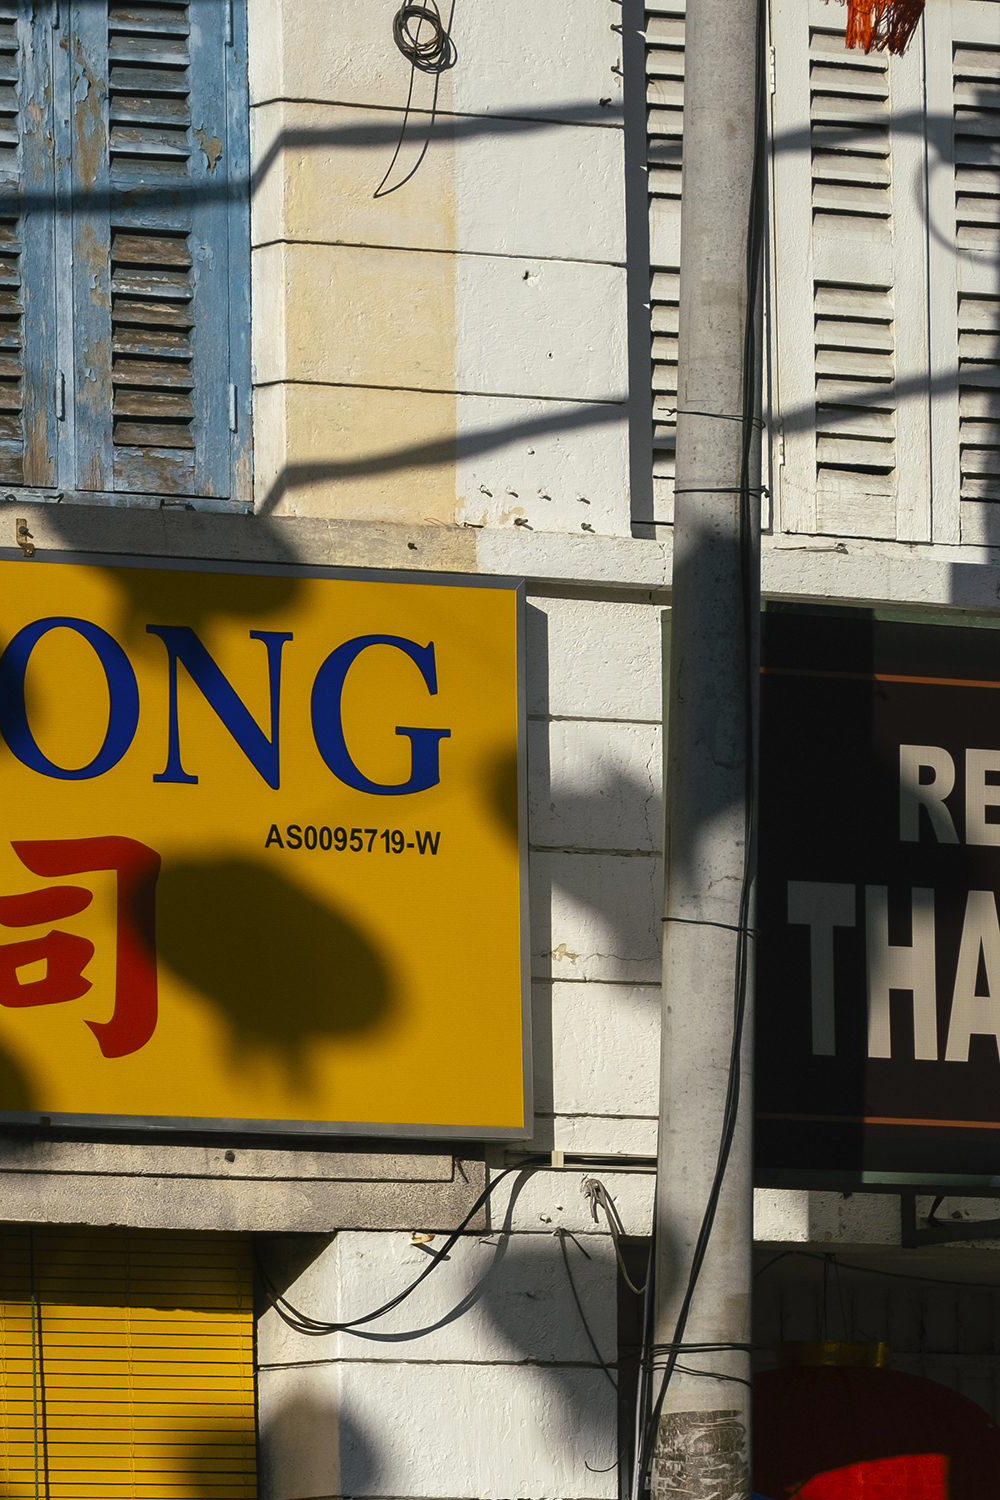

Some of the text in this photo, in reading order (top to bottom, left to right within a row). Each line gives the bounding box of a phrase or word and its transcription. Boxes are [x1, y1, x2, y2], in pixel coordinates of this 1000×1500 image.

[264, 823, 442, 856] AS0095719-W
[899, 744, 1000, 847] RE
[787, 880, 1000, 1063] THA
